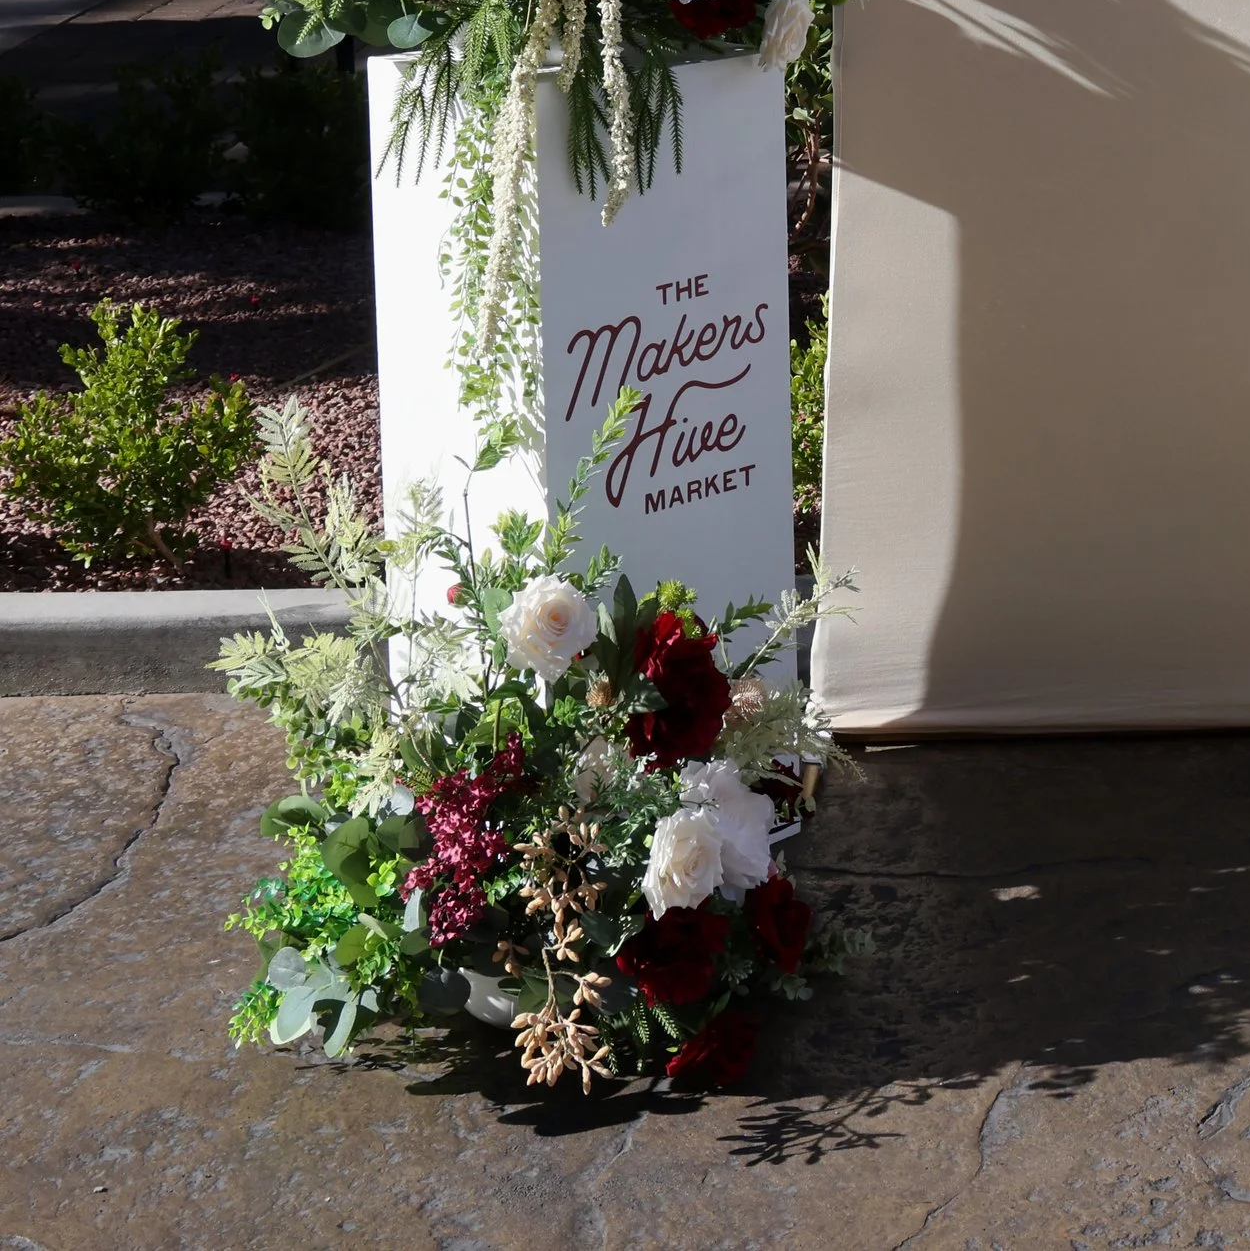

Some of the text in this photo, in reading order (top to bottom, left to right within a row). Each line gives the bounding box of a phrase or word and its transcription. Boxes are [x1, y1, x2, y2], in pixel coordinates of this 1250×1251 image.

[655, 273, 709, 305] THE
[565, 303, 769, 422] Makers
[605, 363, 752, 509] Hive
[643, 464, 757, 515] MARKET
